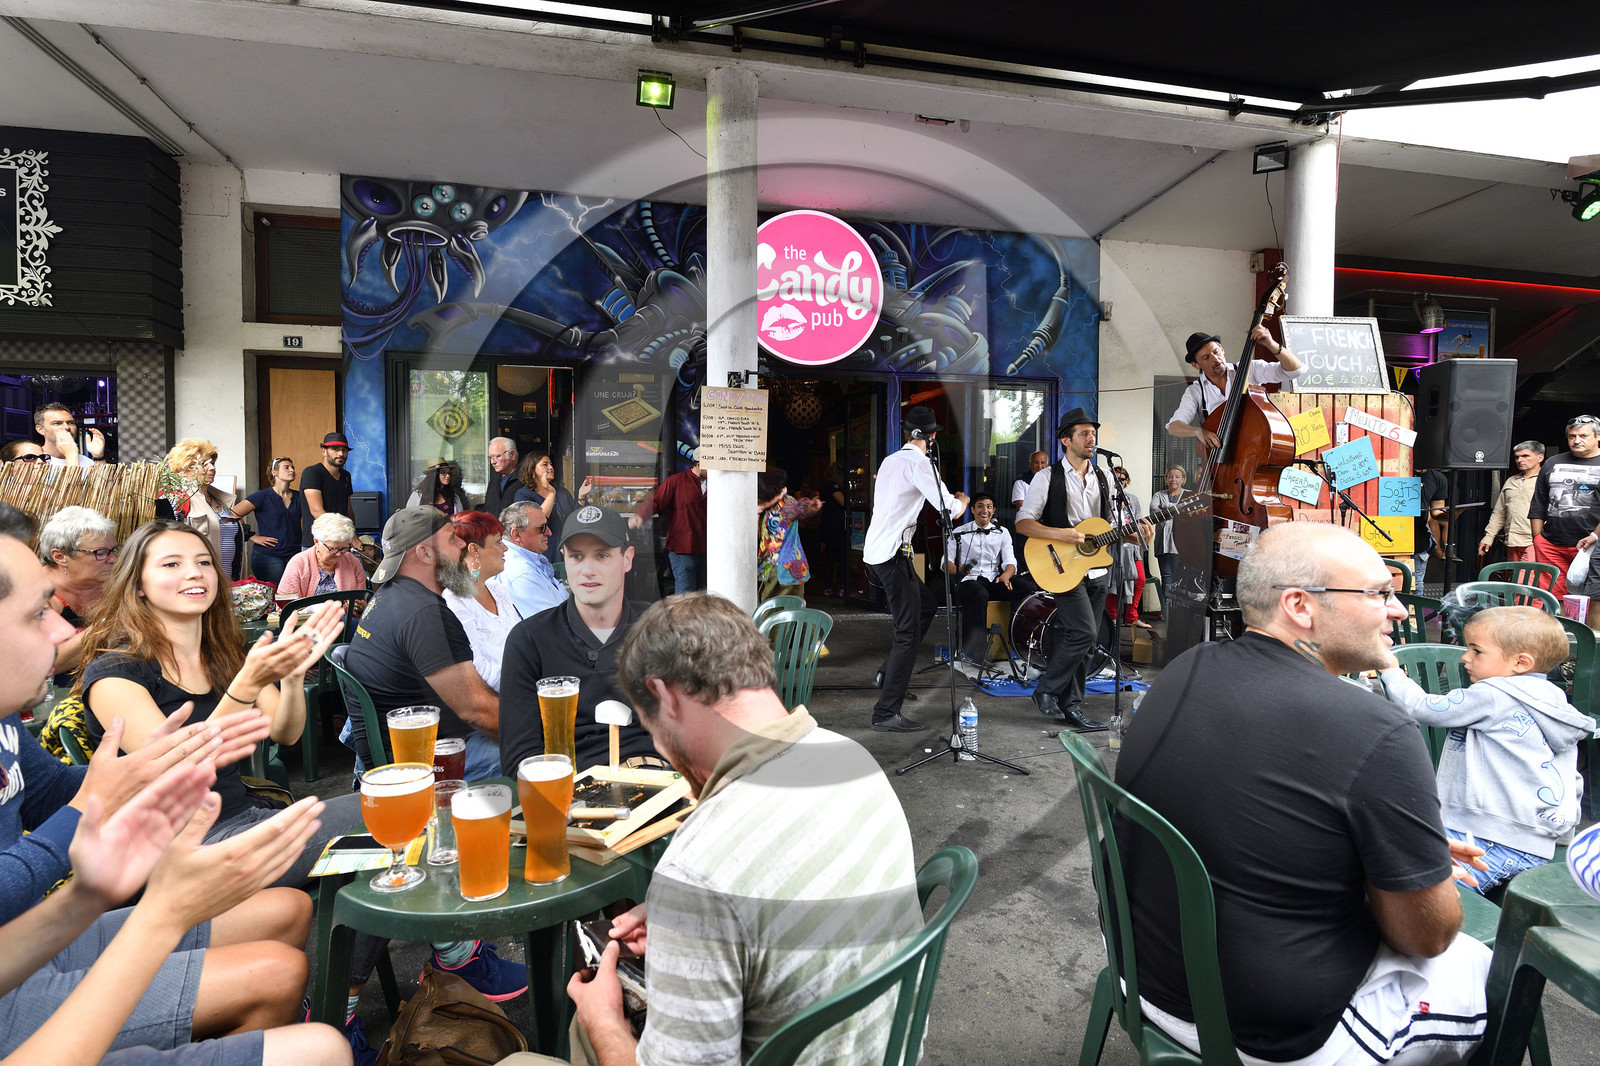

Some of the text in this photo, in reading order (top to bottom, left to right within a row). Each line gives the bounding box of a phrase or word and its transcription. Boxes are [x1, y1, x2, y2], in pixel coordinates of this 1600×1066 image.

[783, 244, 807, 260] the
[811, 308, 843, 331] pub
[286, 338, 299, 346] 19
[1310, 327, 1375, 350] FRENCH
[1298, 349, 1363, 372] TOUCH
[1390, 499, 1408, 513] 2€
